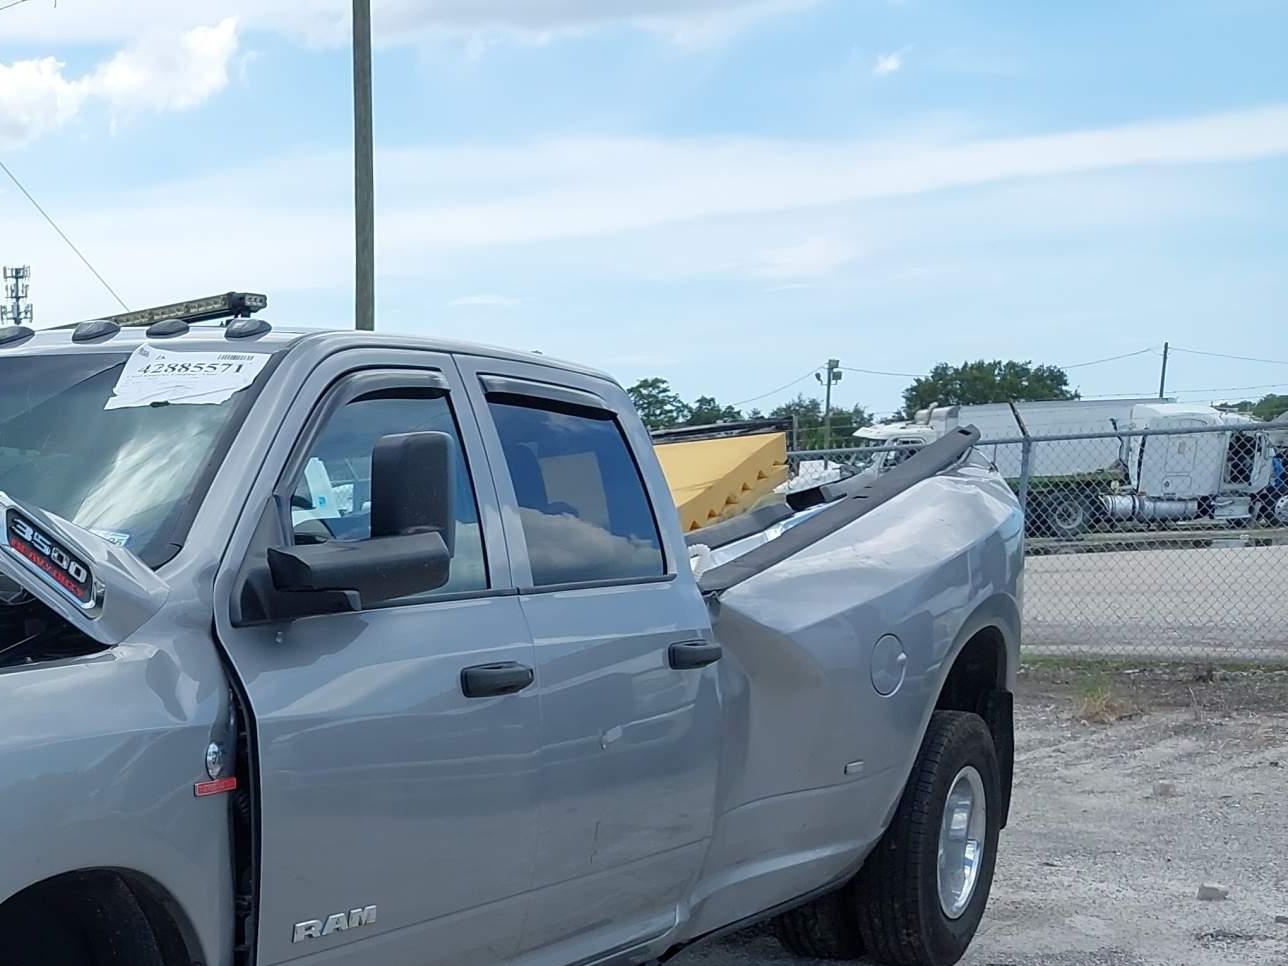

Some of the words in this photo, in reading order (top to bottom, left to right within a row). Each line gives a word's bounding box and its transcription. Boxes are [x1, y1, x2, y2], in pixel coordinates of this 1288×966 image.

[137, 362, 245, 375] 42885571
[11, 518, 88, 584] 3500
[292, 904, 377, 943] RAM
